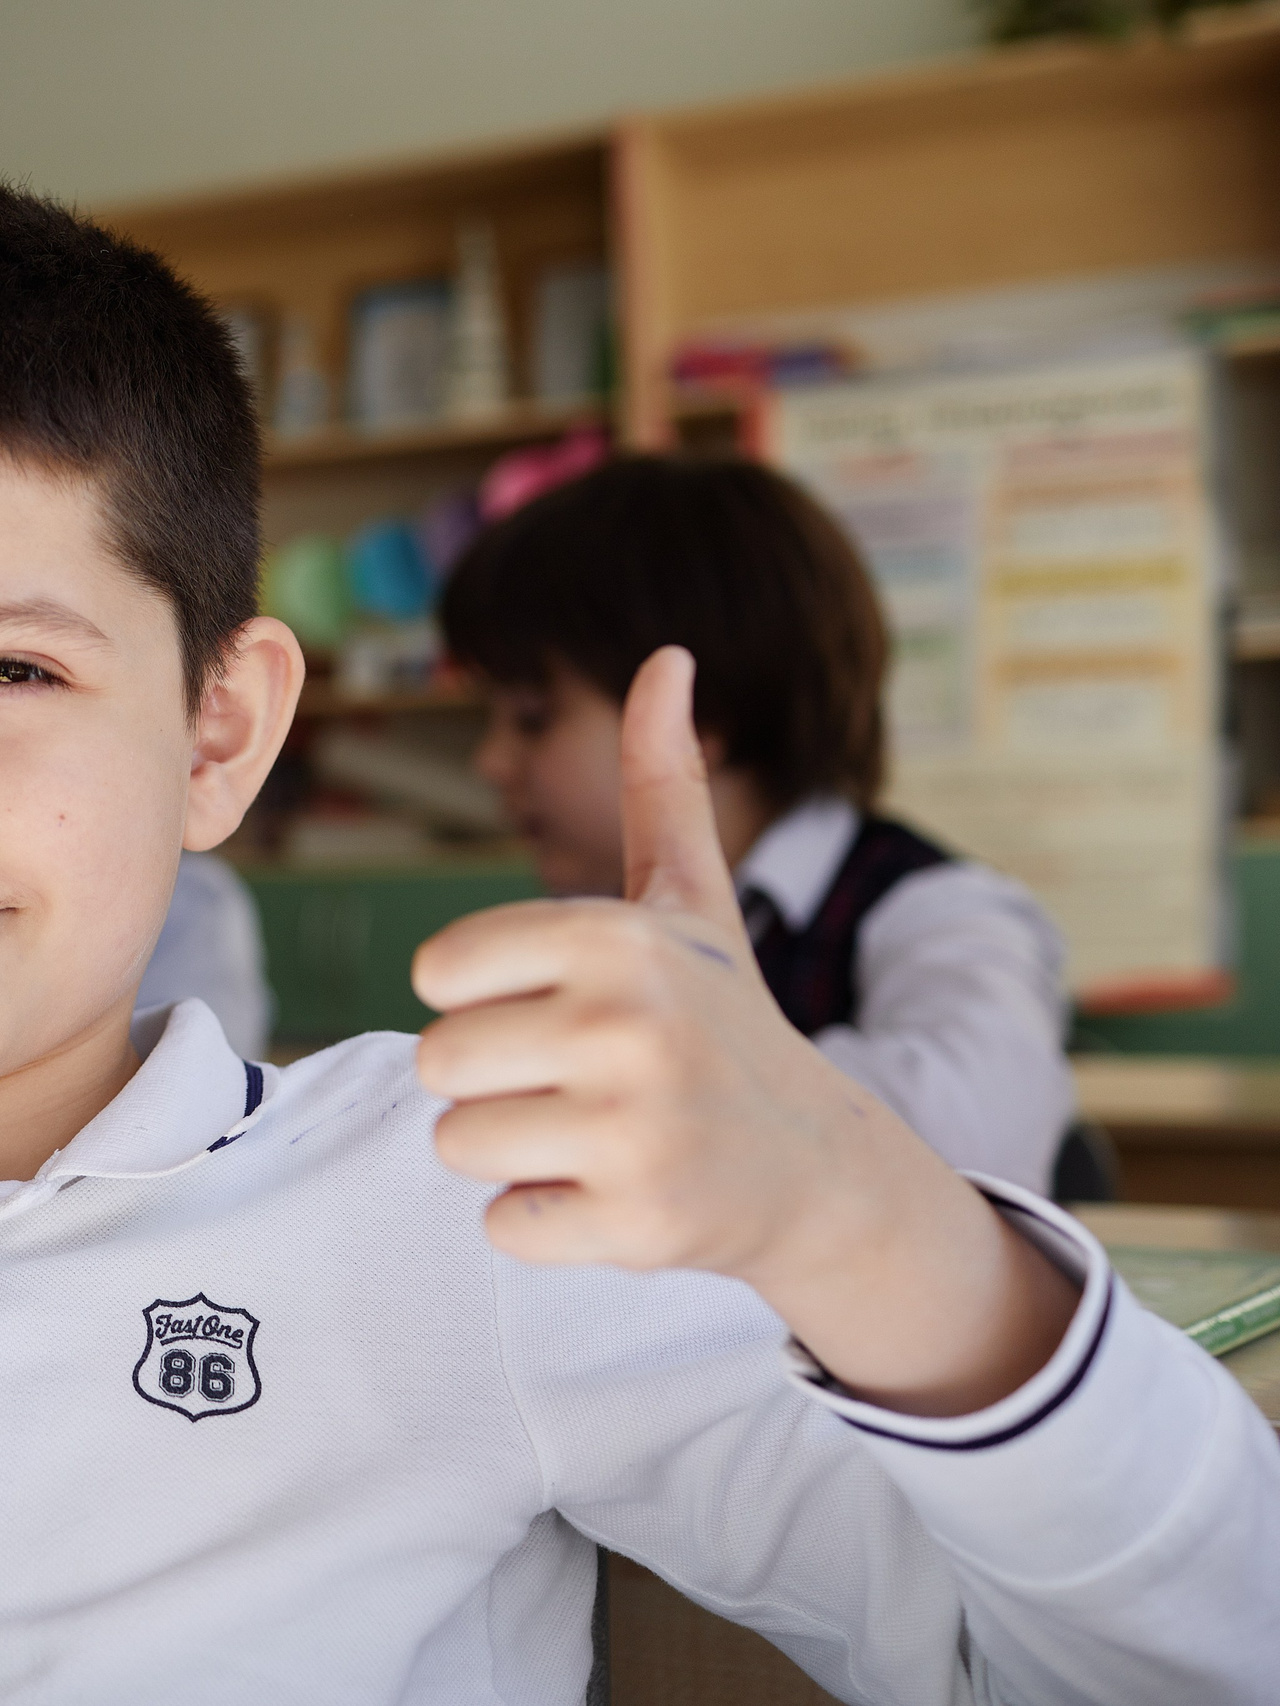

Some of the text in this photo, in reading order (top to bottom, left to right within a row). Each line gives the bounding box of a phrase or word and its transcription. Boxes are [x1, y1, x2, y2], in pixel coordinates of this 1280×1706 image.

[155, 1313, 244, 1345] Fast One
[159, 1349, 235, 1402] 86
